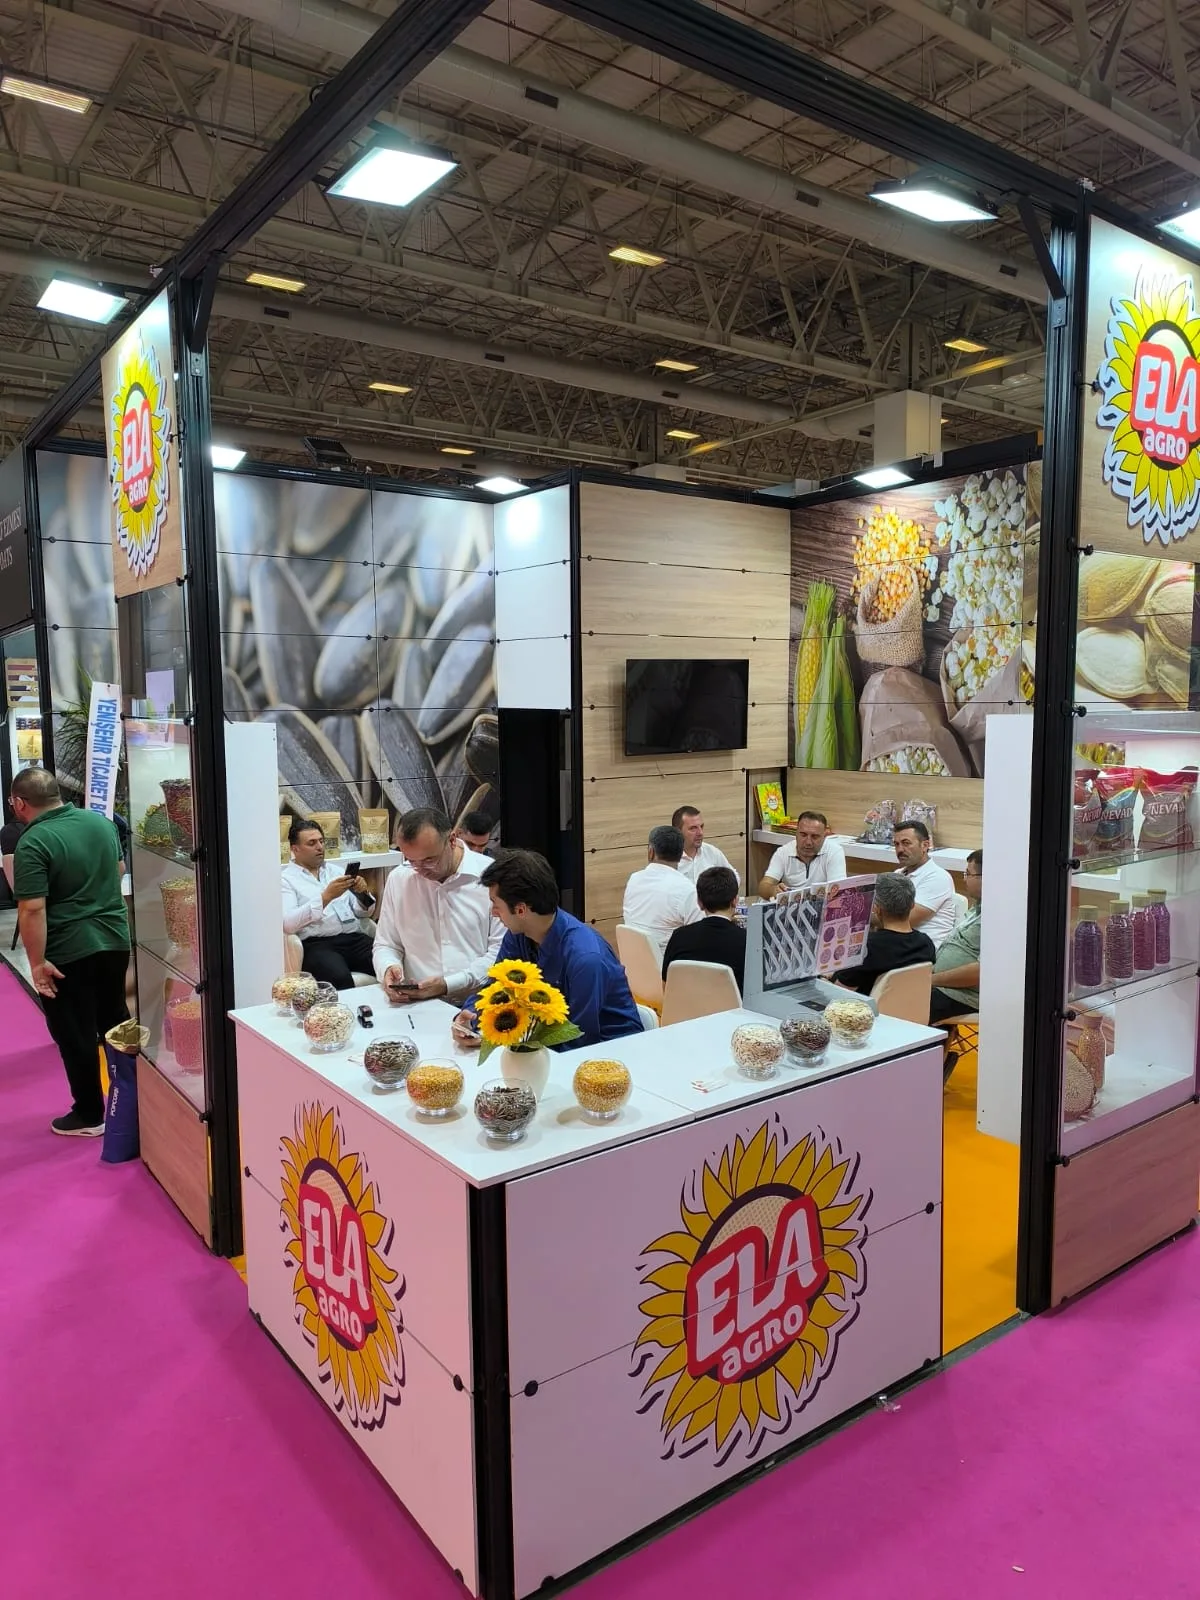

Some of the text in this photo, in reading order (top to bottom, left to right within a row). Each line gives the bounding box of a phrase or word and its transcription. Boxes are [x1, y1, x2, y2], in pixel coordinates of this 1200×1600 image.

[1134, 354, 1197, 433] ELA
[122, 407, 153, 482] ELA
[91, 698, 121, 755] YENİŞEHİR
[90, 757, 115, 802] TİCARET
[302, 1198, 370, 1311] ELA
[695, 1207, 818, 1362] ELA
